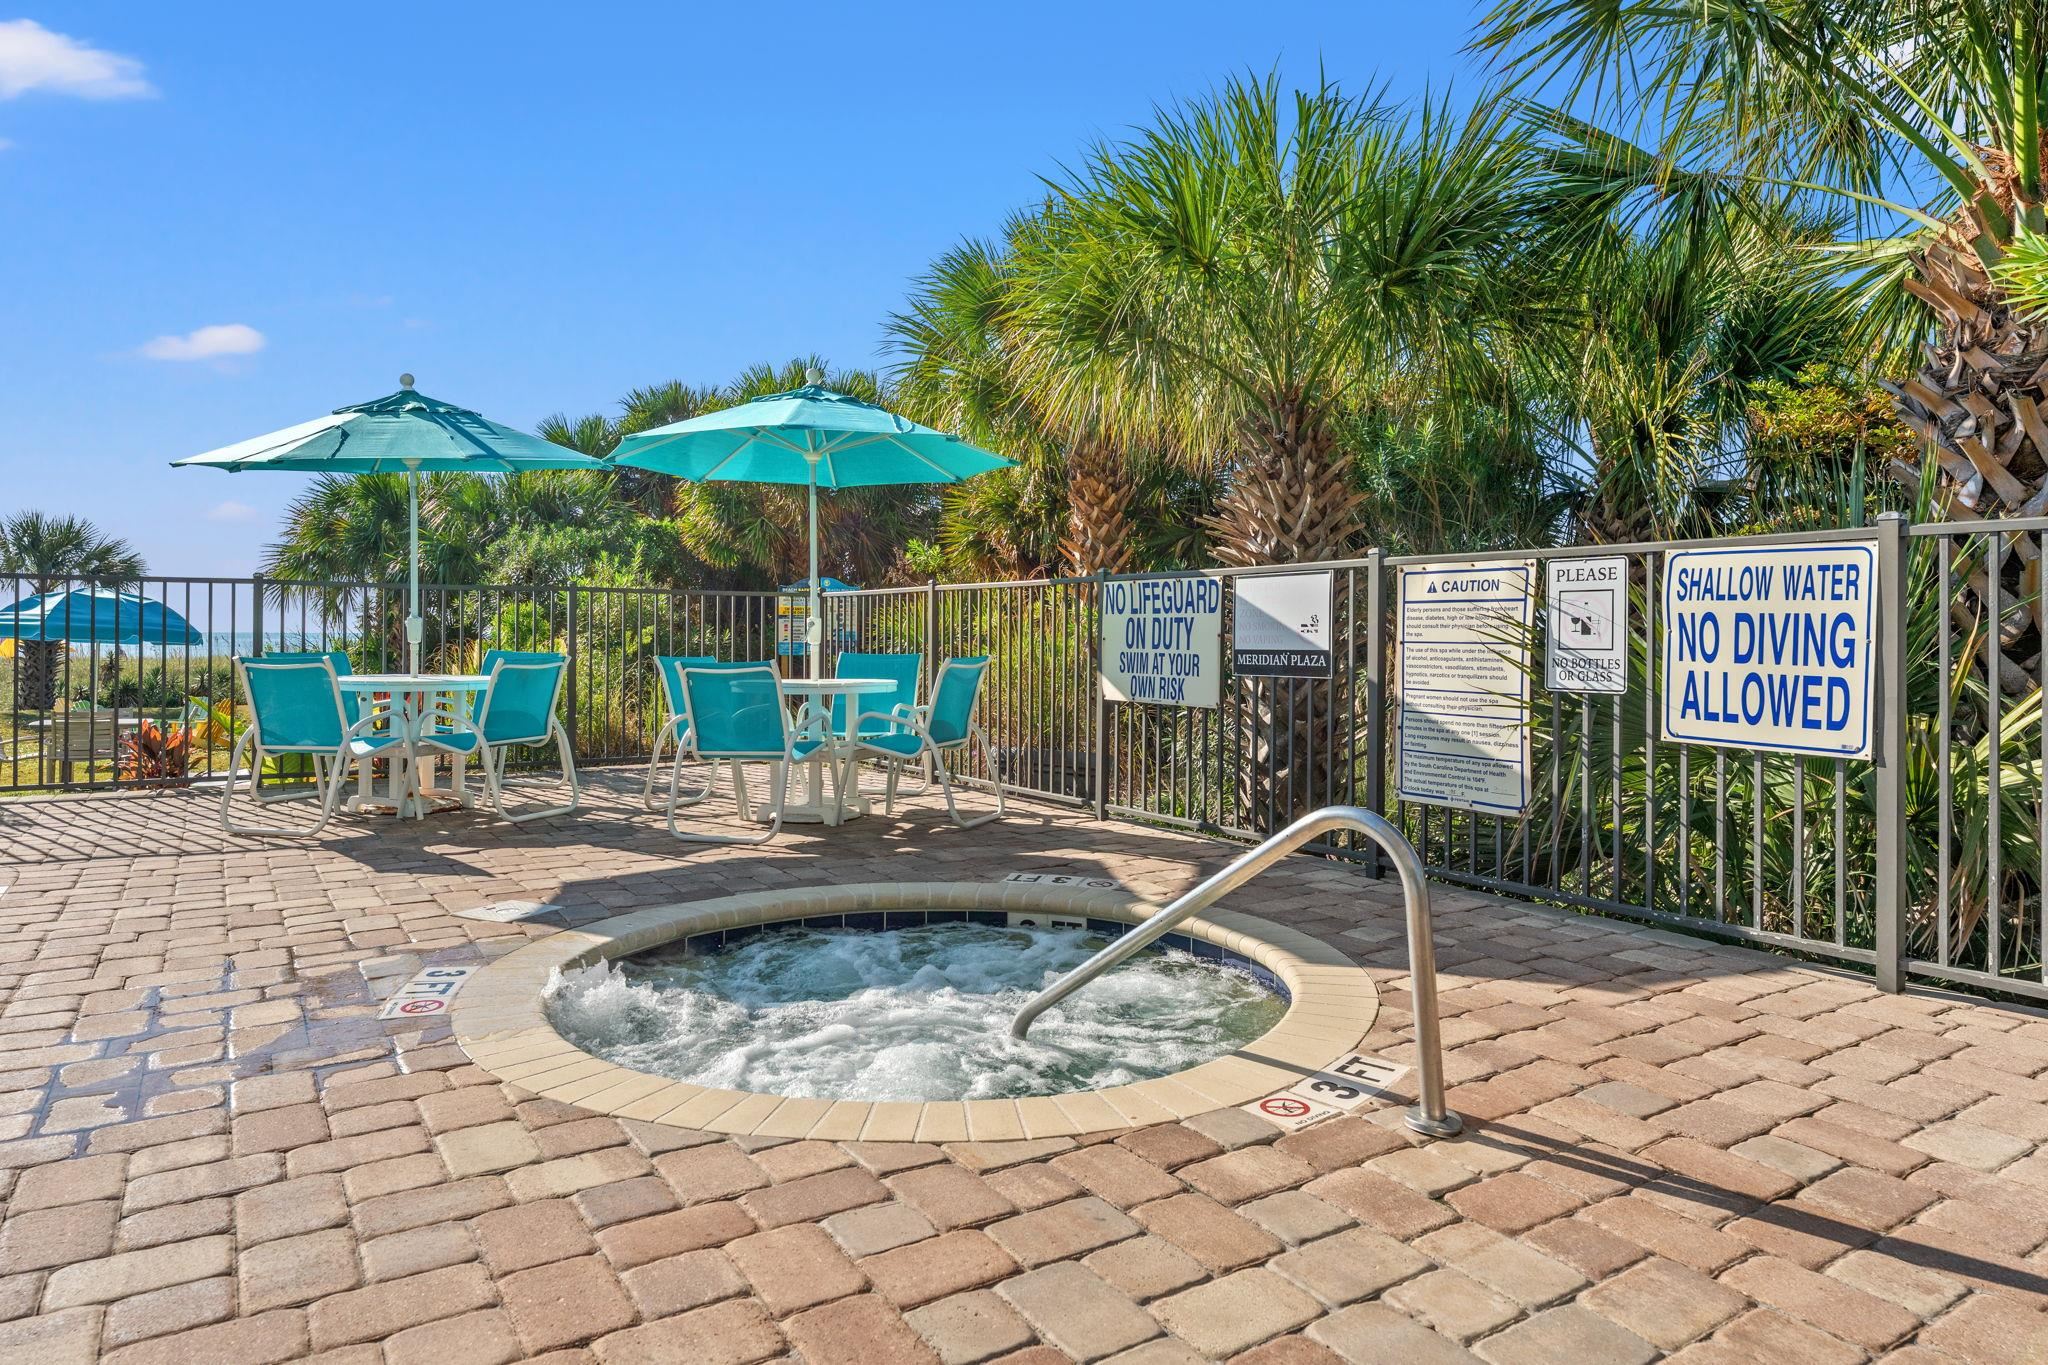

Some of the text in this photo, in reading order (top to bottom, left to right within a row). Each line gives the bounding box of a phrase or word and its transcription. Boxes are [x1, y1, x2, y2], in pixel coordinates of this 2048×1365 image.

[1556, 567, 1618, 582] PLEASE
[1442, 579, 1500, 593] CAUTION
[1677, 564, 1860, 601] SHALLOW WATER
[1105, 580, 1220, 615] NO LIFEGUARD
[1126, 617, 1194, 650] ON DUTY
[1678, 612, 1856, 668] NO DIVING
[1120, 652, 1200, 677] SWIM AT YOUR
[1238, 652, 1327, 667] MERIDIAN PLAZA
[1552, 658, 1621, 670] NO BOTTLES
[1559, 671, 1613, 682] OR GLASS
[1131, 676, 1185, 700] OWN RISK
[1681, 670, 1850, 731] ALLOWED
[1436, 756, 1465, 764] temperature
[1492, 762, 1514, 770] allowed
[1454, 766, 1482, 774] Department
[1413, 770, 1447, 779] Environmental
[1428, 780, 1458, 788] temperature
[1007, 874, 1072, 884] 3 FT
[405, 970, 467, 995] 3 FT
[1311, 1056, 1396, 1100] 3 FT
